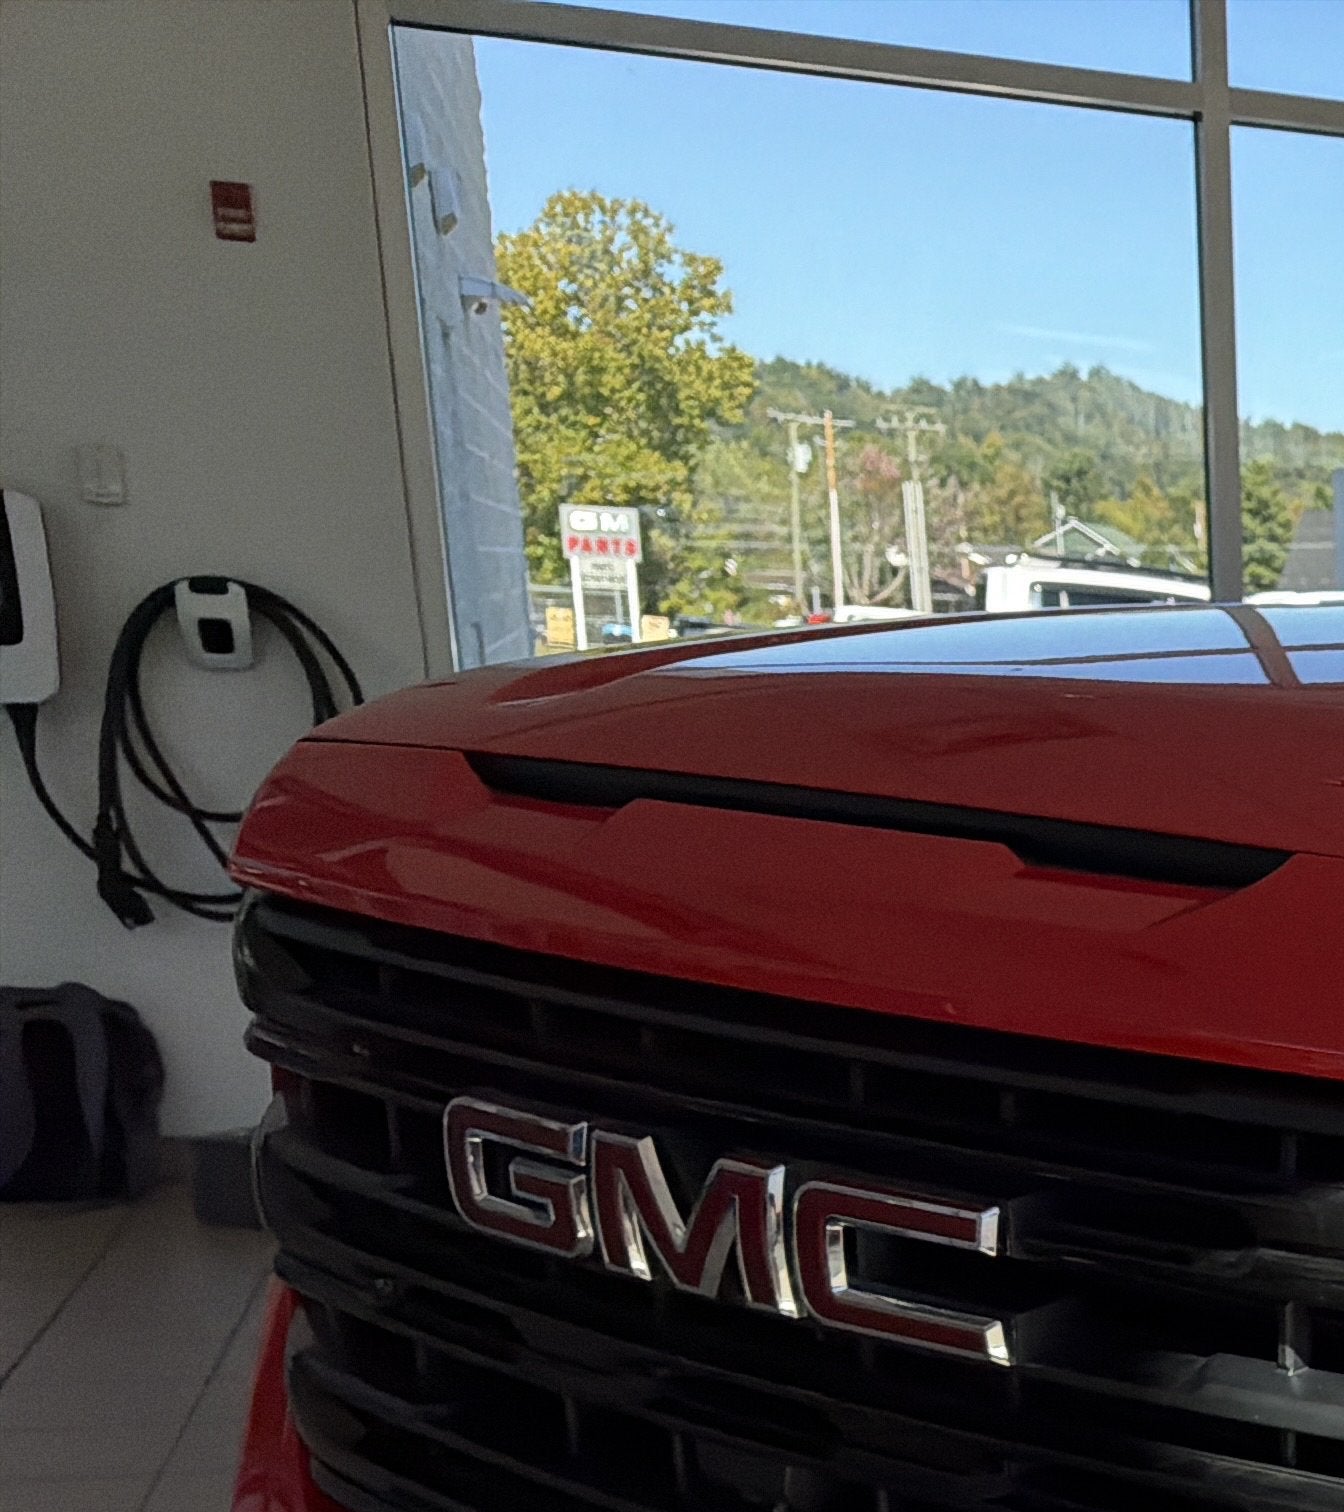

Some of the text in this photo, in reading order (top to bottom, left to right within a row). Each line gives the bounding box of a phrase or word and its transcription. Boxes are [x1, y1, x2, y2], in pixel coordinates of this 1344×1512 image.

[569, 510, 630, 532] GM
[566, 535, 638, 557] PARTS
[443, 1096, 1011, 1366] GMC
